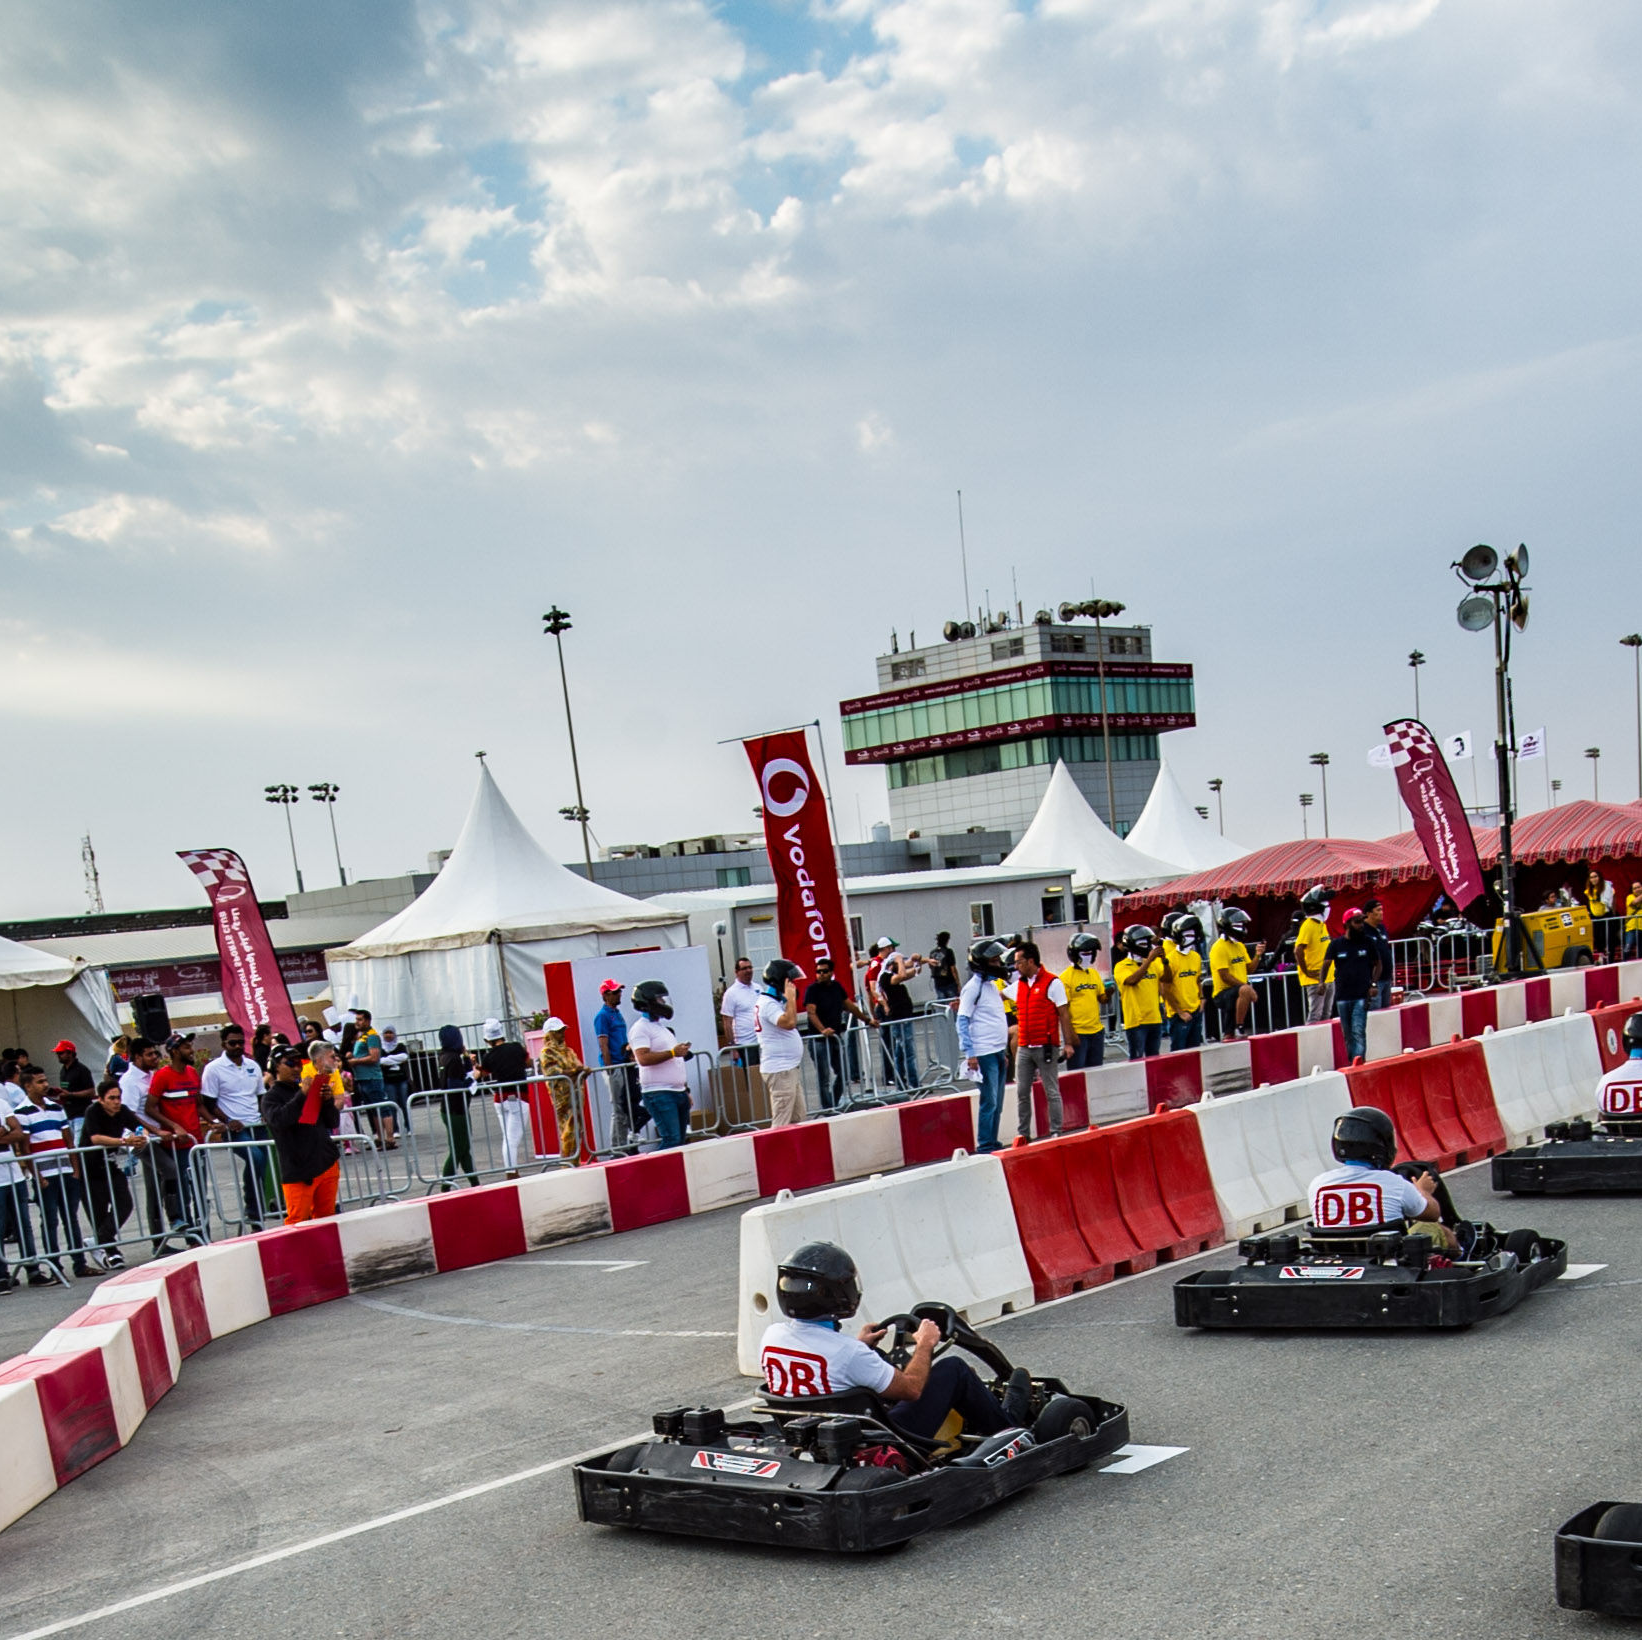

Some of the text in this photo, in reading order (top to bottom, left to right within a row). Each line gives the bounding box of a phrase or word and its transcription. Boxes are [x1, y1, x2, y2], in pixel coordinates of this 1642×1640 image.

[783, 823, 832, 964] vodafon
[1322, 1191, 1374, 1226] DB
[765, 1357, 820, 1397] DB
